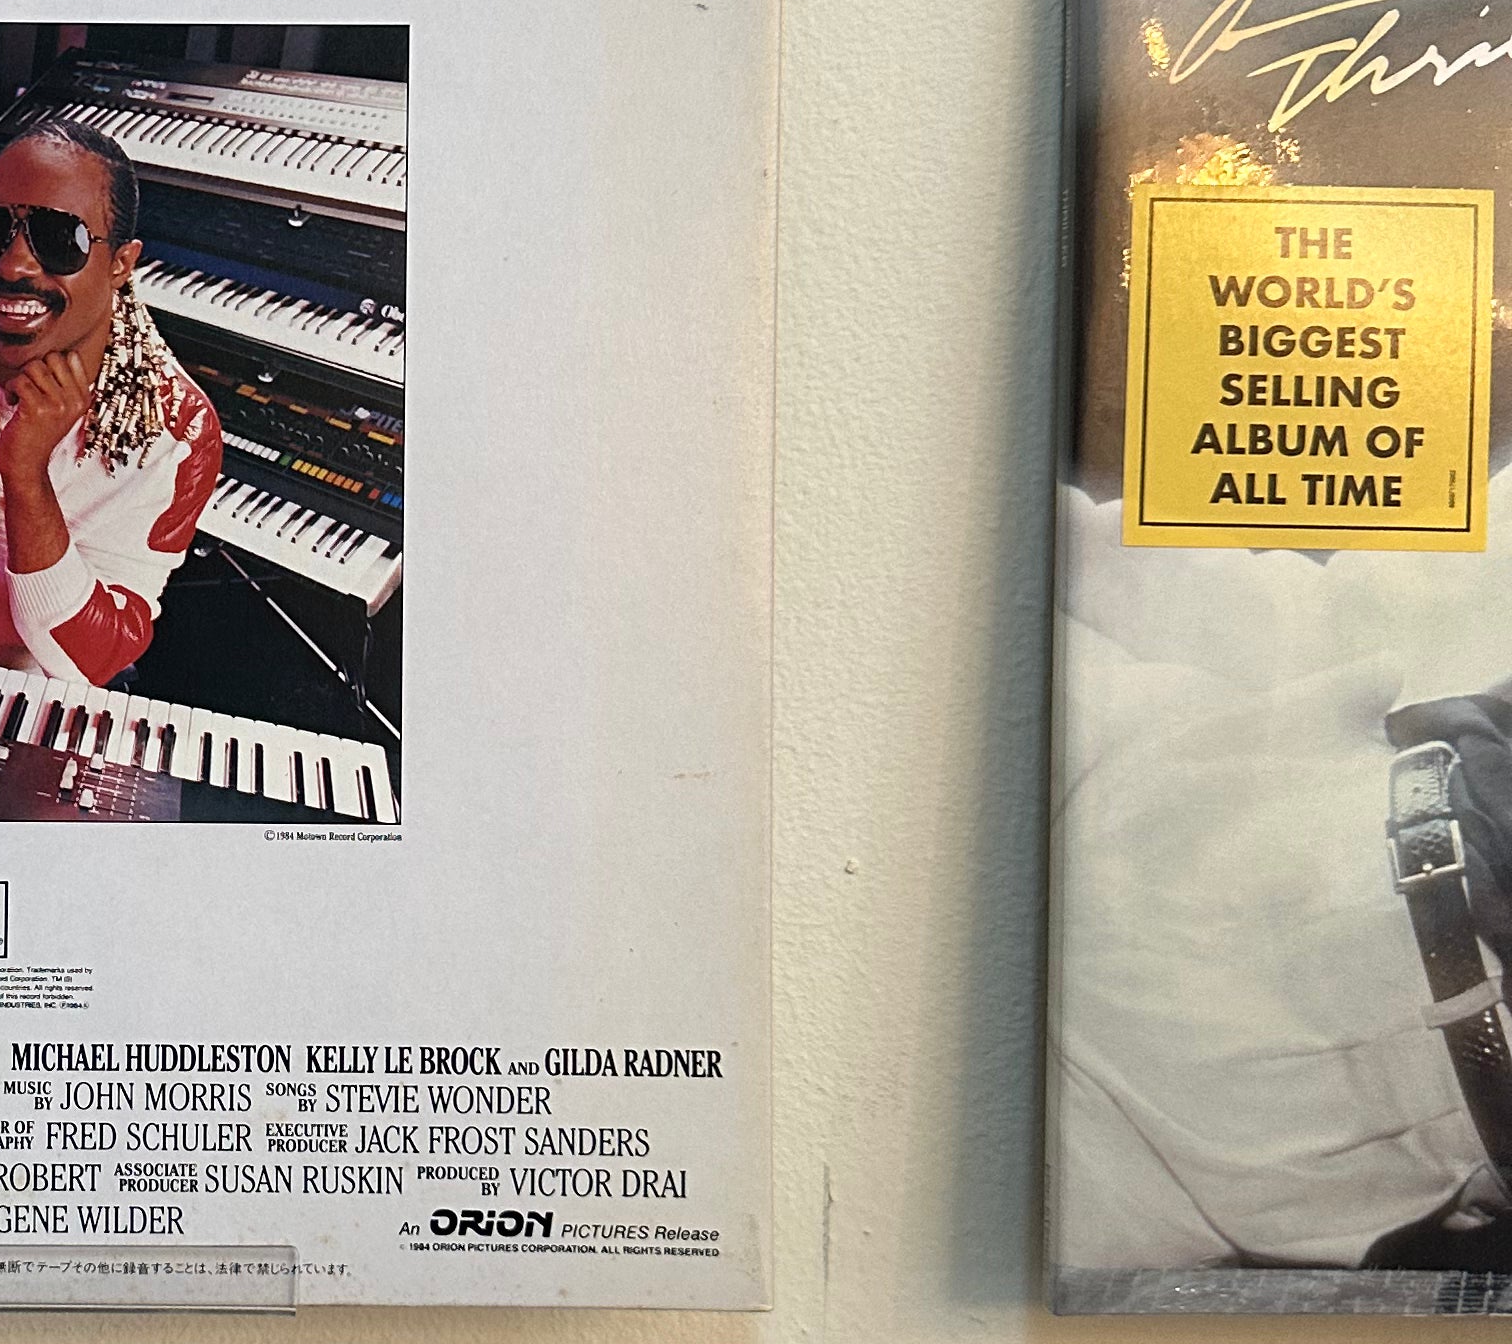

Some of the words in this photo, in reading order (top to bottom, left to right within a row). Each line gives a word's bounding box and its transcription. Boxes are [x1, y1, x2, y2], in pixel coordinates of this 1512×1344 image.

[1275, 227, 1352, 259] THE
[1208, 275, 1415, 310] WORLD'S
[1219, 325, 1405, 359] BIGGEST
[1220, 374, 1399, 409] SELLING
[1191, 423, 1348, 456] ALBUM
[1367, 426, 1424, 458] OF
[1210, 473, 1286, 505] ALL
[1302, 474, 1401, 507] TIME
[12, 1043, 119, 1071] MICHAEL
[126, 1044, 291, 1072] HUDDLESTON
[307, 1046, 378, 1073] KELLY
[385, 1047, 412, 1073] LE
[420, 1047, 501, 1075] BROCK
[508, 1062, 539, 1075] AND
[545, 1048, 618, 1076] GILDA
[624, 1050, 722, 1077] RADNER
[60, 1082, 134, 1110] JOHN
[145, 1083, 251, 1111] MORRIS
[326, 1084, 419, 1113] STEVIE
[428, 1086, 551, 1114] WONDER
[47, 1122, 116, 1150] FRED
[127, 1123, 252, 1151] SCHULER
[355, 1126, 419, 1153] JACK
[429, 1127, 515, 1154] FROST
[525, 1127, 649, 1157] SANDERS
[205, 1165, 292, 1193] SUSAN
[303, 1166, 403, 1194] RUSKIN
[510, 1168, 612, 1197] VICTOR
[622, 1170, 686, 1198] DRAI
[77, 1206, 184, 1234] WILDER
[399, 1222, 419, 1235] An
[562, 1224, 649, 1239] PICTURES
[655, 1226, 719, 1241] Release
